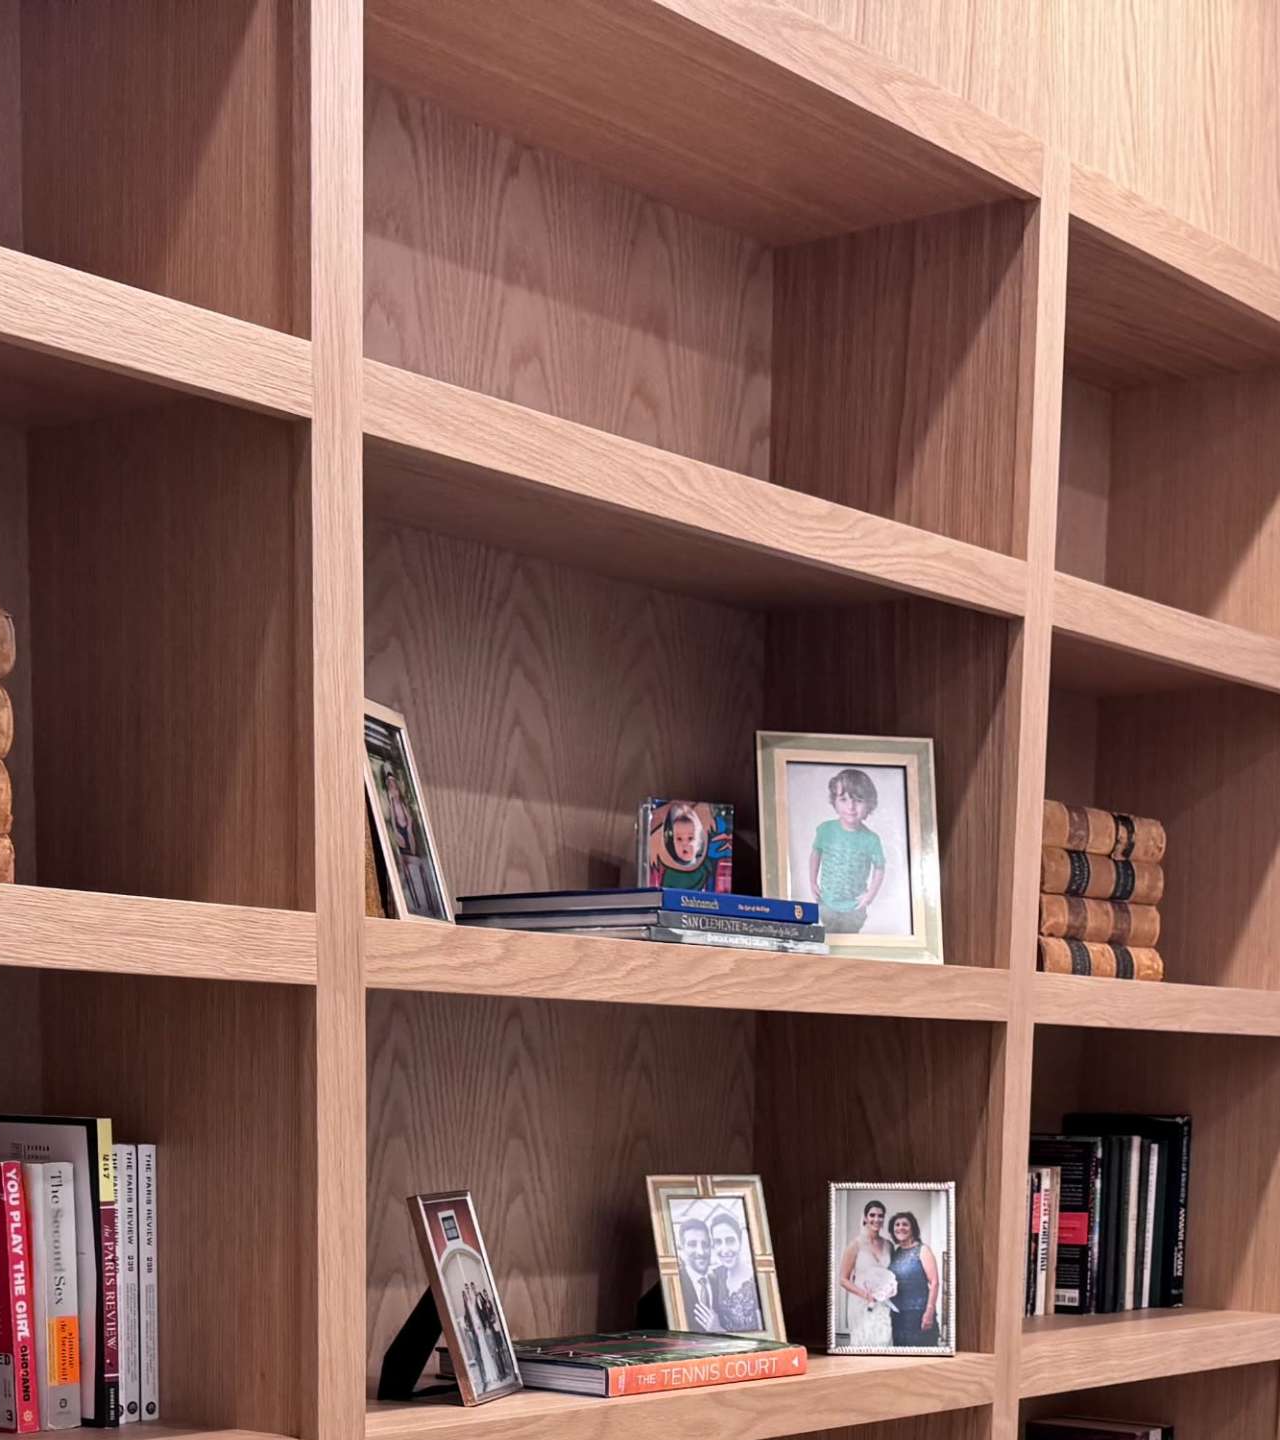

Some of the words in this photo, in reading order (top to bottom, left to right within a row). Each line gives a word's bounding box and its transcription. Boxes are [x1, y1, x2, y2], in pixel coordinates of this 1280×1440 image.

[125, 1151, 133, 1171] THE
[144, 1153, 152, 1173] THE
[6, 1168, 20, 1207] YOU
[50, 1170, 64, 1206] The
[125, 1174, 134, 1206] PARIS
[145, 1176, 153, 1206] PARIS
[10, 1210, 24, 1256] PLAY
[50, 1208, 66, 1274] Second
[146, 1208, 154, 1247] REVIEW
[13, 1261, 26, 1297] THE
[104, 1241, 116, 1286] PARIS
[54, 1274, 67, 1305] Sex
[15, 1300, 31, 1342] GIRL
[105, 1288, 118, 1350] REVIEW
[636, 1373, 657, 1385] THE
[661, 1365, 720, 1386] TENNIS
[725, 1357, 778, 1379] COURT
[6, 1409, 14, 1422] 3
